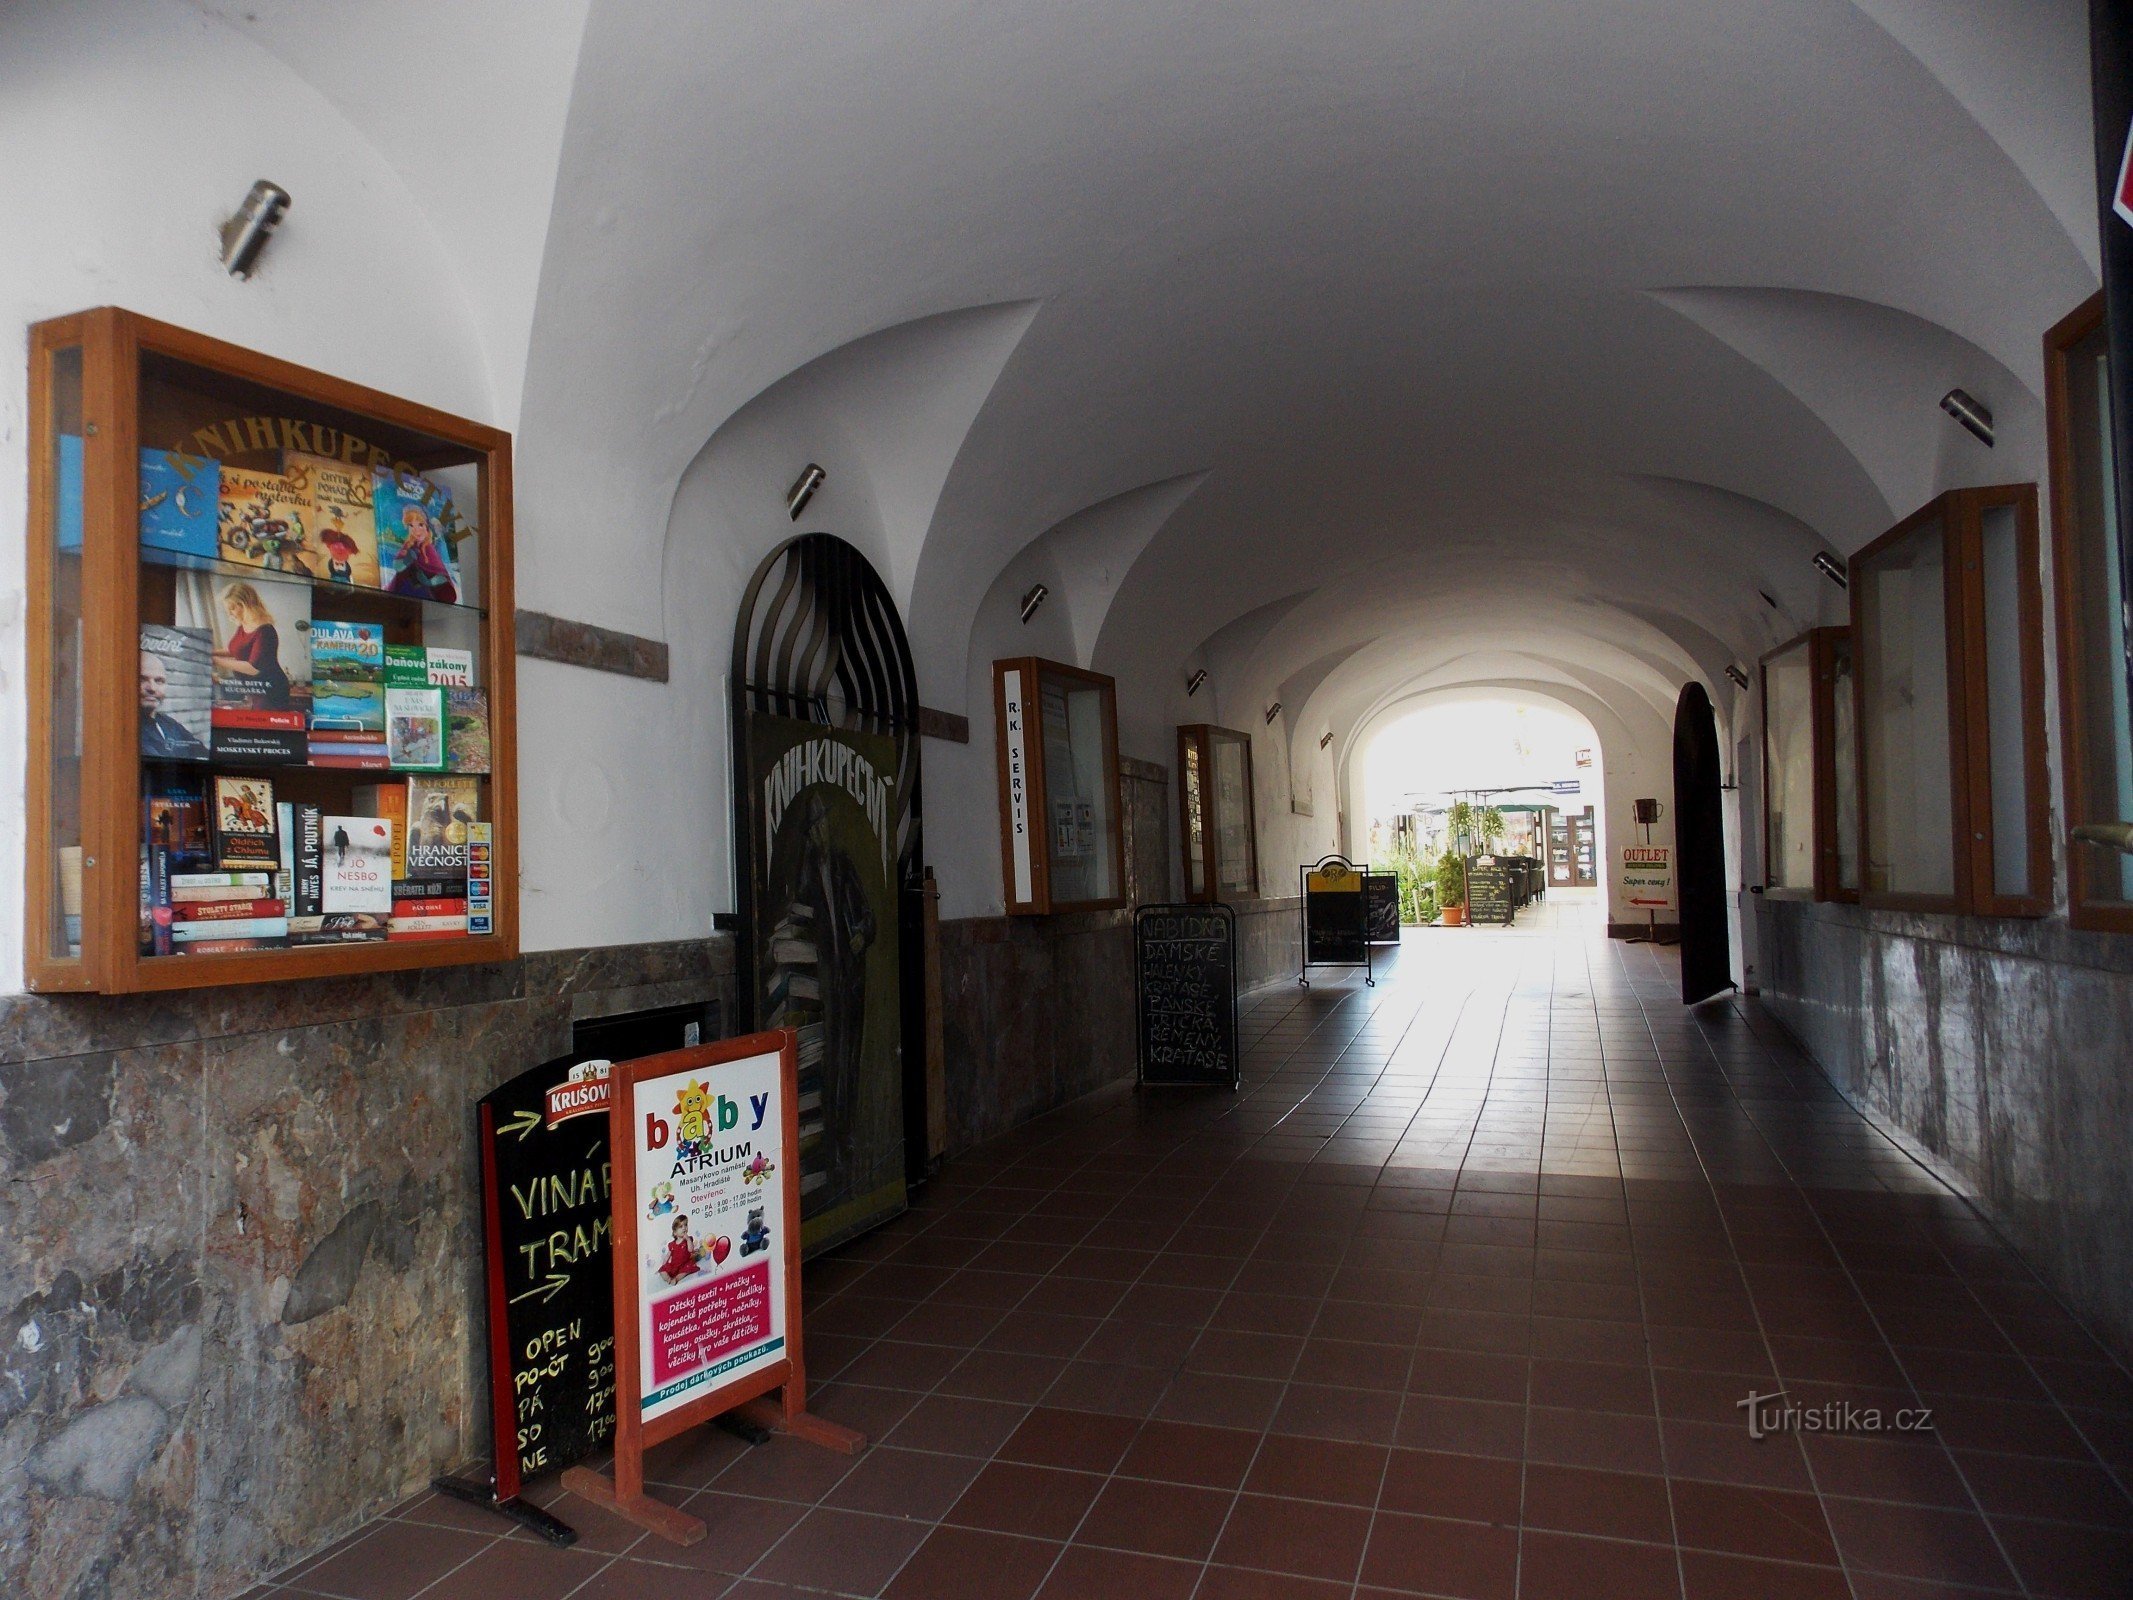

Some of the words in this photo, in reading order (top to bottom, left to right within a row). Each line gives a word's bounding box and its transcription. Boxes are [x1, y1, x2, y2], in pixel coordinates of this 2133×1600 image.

[165, 417, 479, 543] KNIHKUPECTVÍ
[140, 635, 189, 653] ování
[358, 643, 379, 658] 20
[385, 655, 426, 669] Daňové
[429, 659, 467, 674] zákony
[430, 672, 467, 687] 2015
[263, 748, 292, 756] PROCES
[1011, 747, 1024, 834] SERVIS
[764, 738, 895, 892] KNIHKUPECTVÍ
[302, 808, 319, 853] POUTNÍK
[350, 859, 365, 869] JO
[408, 853, 468, 867] VĚČNOST
[1623, 848, 1669, 862] OUTLET
[310, 874, 320, 899] HAYES
[337, 871, 378, 881] NESBØ
[1622, 875, 1646, 887] Super
[1647, 878, 1665, 888] ceny
[600, 1067, 608, 1075] 81
[646, 1091, 769, 1152] baby
[669, 1141, 752, 1180] ATRIUM
[679, 1169, 721, 1188] Masarykovo
[720, 1161, 747, 1177] náměstí
[690, 1184, 703, 1194] Uh.
[703, 1174, 731, 1191] Hradiště
[690, 1187, 727, 1204] Otevřeno:
[691, 1207, 700, 1216] PO
[704, 1202, 713, 1212] PÁ
[733, 1192, 747, 1204] 17.00
[747, 1187, 763, 1200] hodin
[704, 1209, 713, 1219] SO
[732, 1199, 747, 1211] 11.00
[747, 1194, 762, 1206] hodin
[658, 1310, 696, 1332] kojenecké
[698, 1298, 728, 1319] potřeby
[736, 1284, 766, 1301] dudlíky,
[669, 1295, 696, 1315] Dětský
[697, 1287, 718, 1303] textil
[725, 1275, 750, 1292] hračky
[663, 1323, 701, 1345] kousátka,
[702, 1310, 730, 1328] nádobí,
[731, 1298, 763, 1315] nočníky,
[525, 1318, 582, 1361] OPEN
[667, 1340, 692, 1360] pleny,
[694, 1328, 721, 1346] osušky,
[667, 1351, 696, 1369] věcičky
[713, 1335, 730, 1349] vaše
[731, 1322, 760, 1341] dětičky
[514, 1353, 570, 1395] PO-ČT
[659, 1380, 689, 1399] Prodej
[689, 1360, 733, 1385] dárkových
[733, 1346, 769, 1366] poukazů.
[518, 1384, 545, 1424] PÁ
[517, 1423, 543, 1451] SO
[522, 1446, 548, 1473] NE
